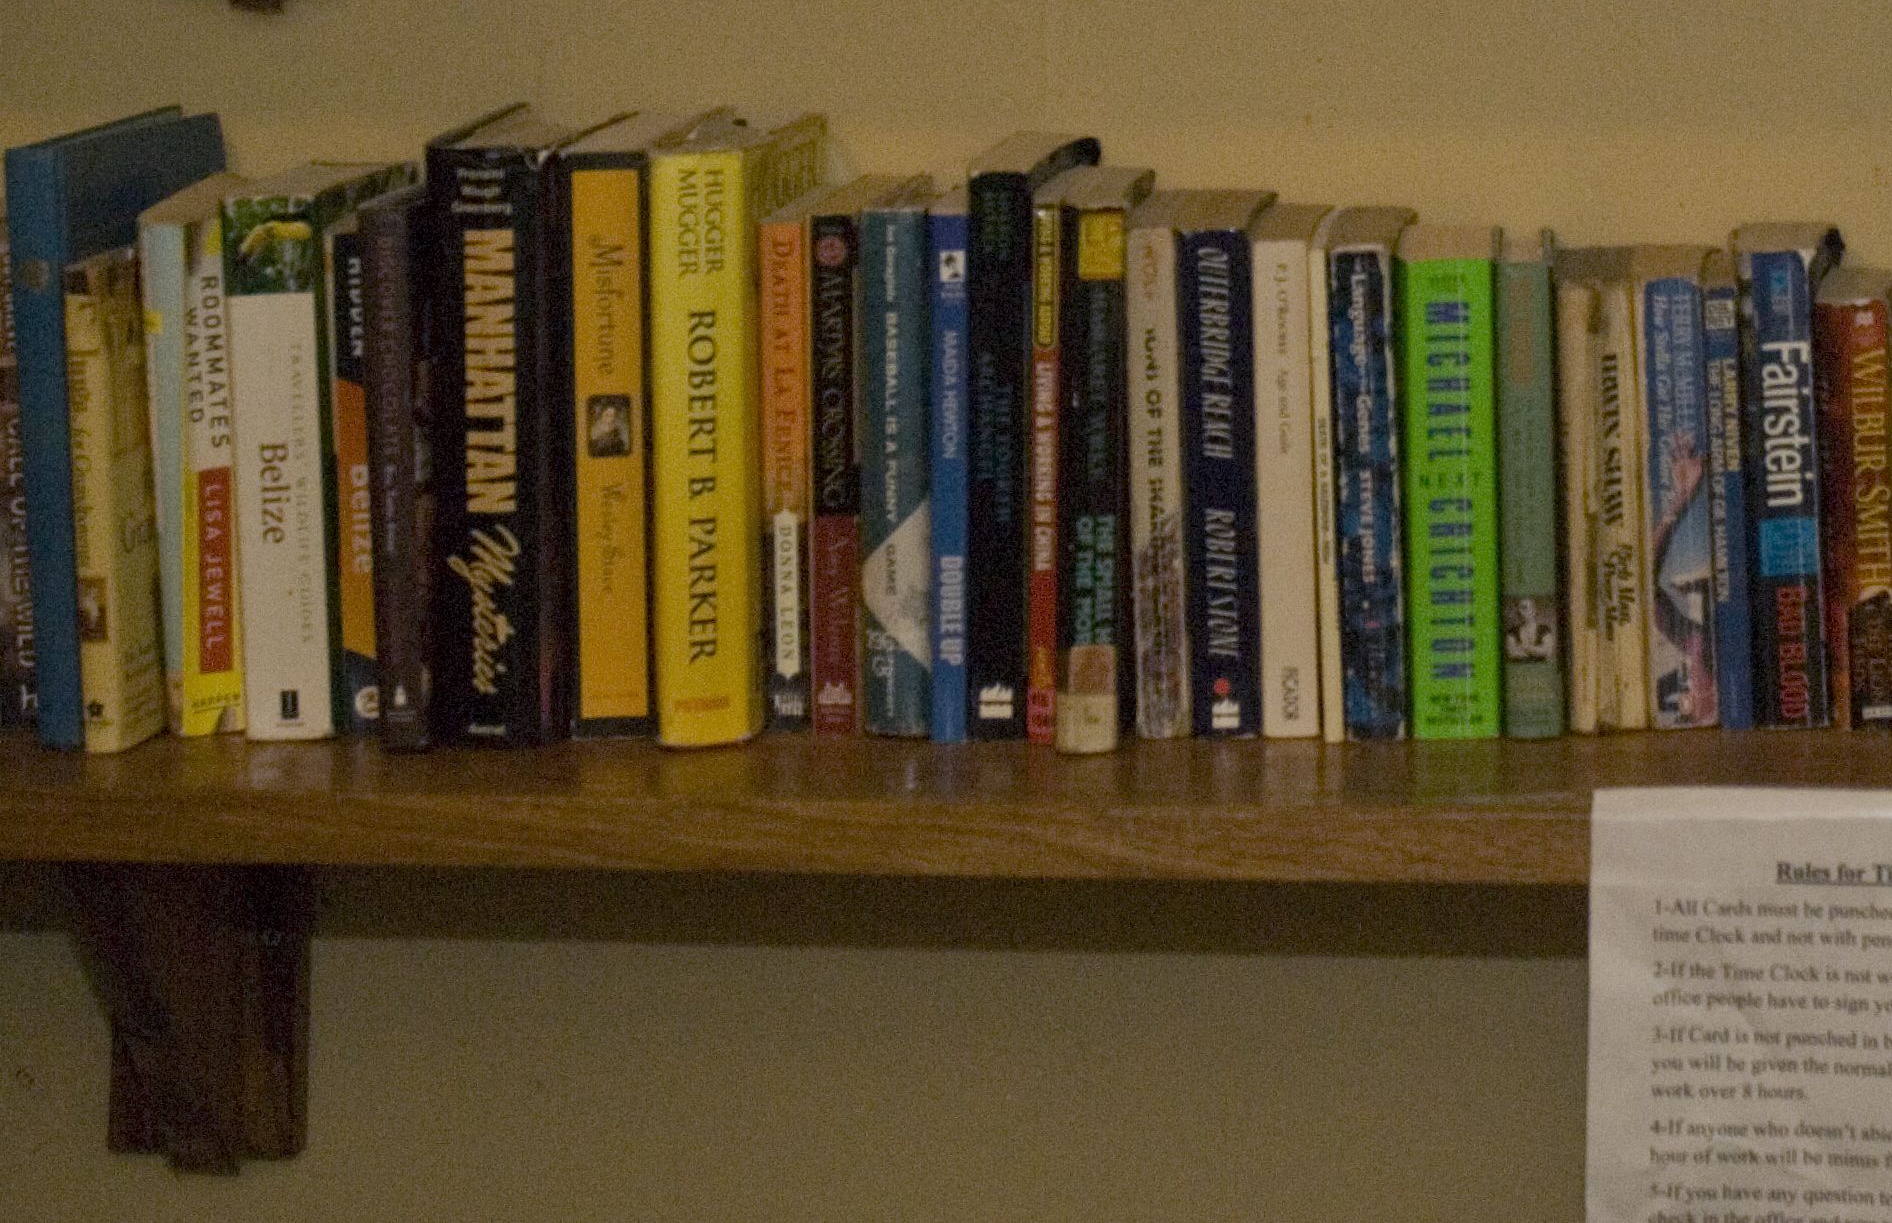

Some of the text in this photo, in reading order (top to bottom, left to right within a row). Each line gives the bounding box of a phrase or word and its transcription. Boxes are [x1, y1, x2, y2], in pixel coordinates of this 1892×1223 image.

[677, 166, 701, 280] MUGGER
[703, 168, 726, 276] HUGGER
[184, 305, 205, 425] WANTED
[200, 274, 231, 450] ROOMMATES
[587, 234, 626, 376] Misfortune
[771, 238, 798, 492] DEATH AT LA FENICE
[1197, 247, 1236, 459] OUTERBRIDGE REACH
[685, 309, 718, 464] ROBERT
[1760, 339, 1812, 508] Fairstein
[258, 441, 288, 545] Belize
[446, 228, 518, 697] MANHATTAN Mysteries
[1358, 470, 1376, 583] STEVE JONES
[1424, 300, 1477, 682] MICHAEL CRICHTON
[1850, 346, 1892, 585] WILBUR SMITH
[202, 483, 227, 649] LISA JEWELL
[688, 516, 718, 666] PARKER
[777, 524, 798, 663] DONNA LEON
[939, 555, 965, 666] DOUBLE UP
[1201, 508, 1240, 659] ROBERT STONE
[1777, 585, 1809, 720] BAD BLOOD
[1653, 927, 1690, 943] time
[1695, 925, 1746, 945] Clock
[1751, 928, 1782, 945] and
[1787, 931, 1814, 946] not
[1819, 930, 1858, 947] with
[1702, 897, 1753, 917] Cards
[1757, 903, 1798, 918] must
[1803, 901, 1824, 919] be
[1776, 860, 1831, 884] Rules
[1836, 862, 1866, 885] for
